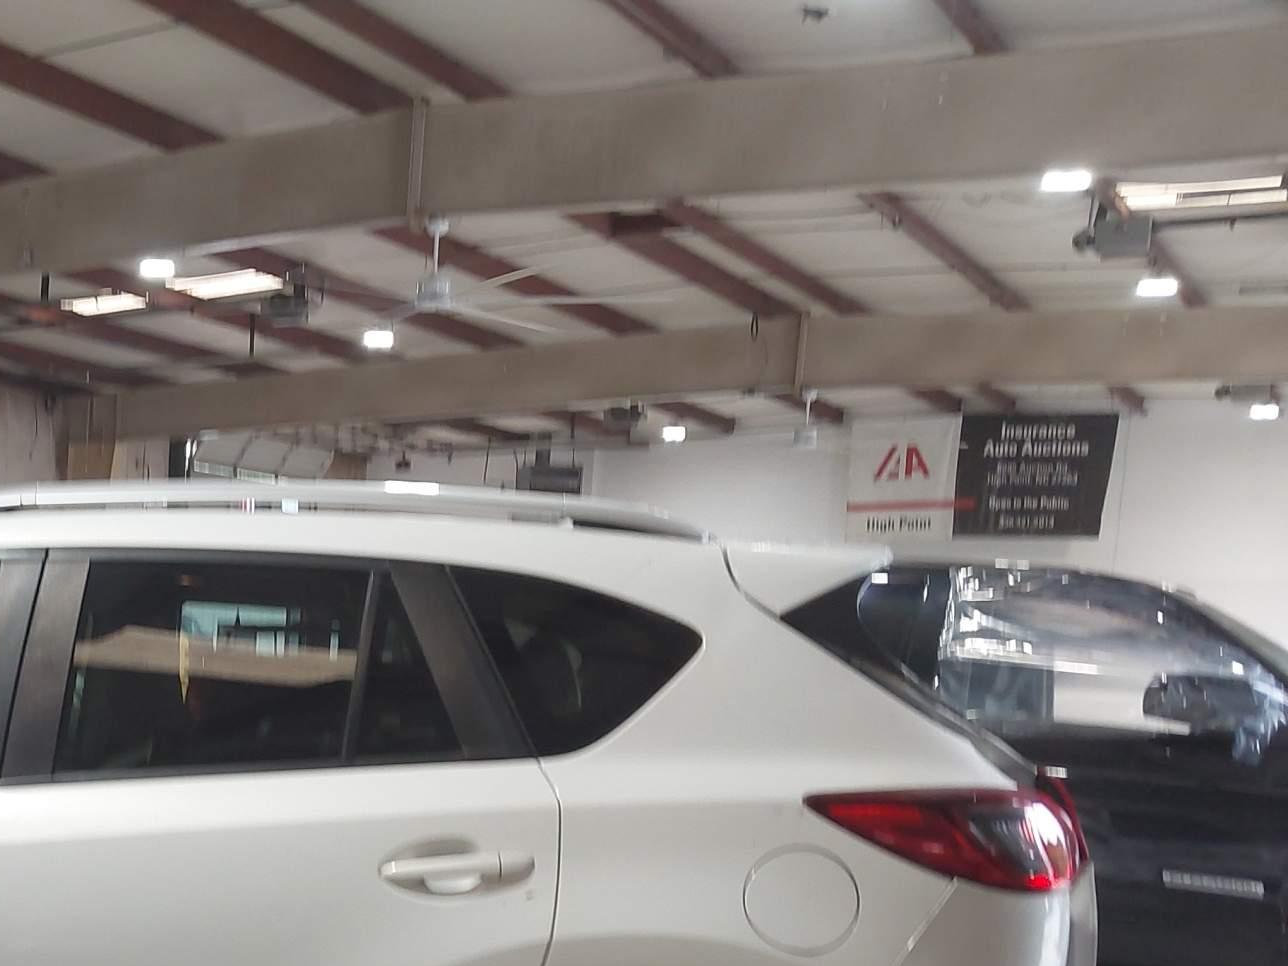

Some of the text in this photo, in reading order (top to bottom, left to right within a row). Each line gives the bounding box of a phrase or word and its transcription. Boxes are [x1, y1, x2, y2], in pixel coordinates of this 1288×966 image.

[1001, 421, 1076, 440] Insurance
[983, 438, 1089, 458] Auto Auctions
[866, 515, 931, 534] High Point
